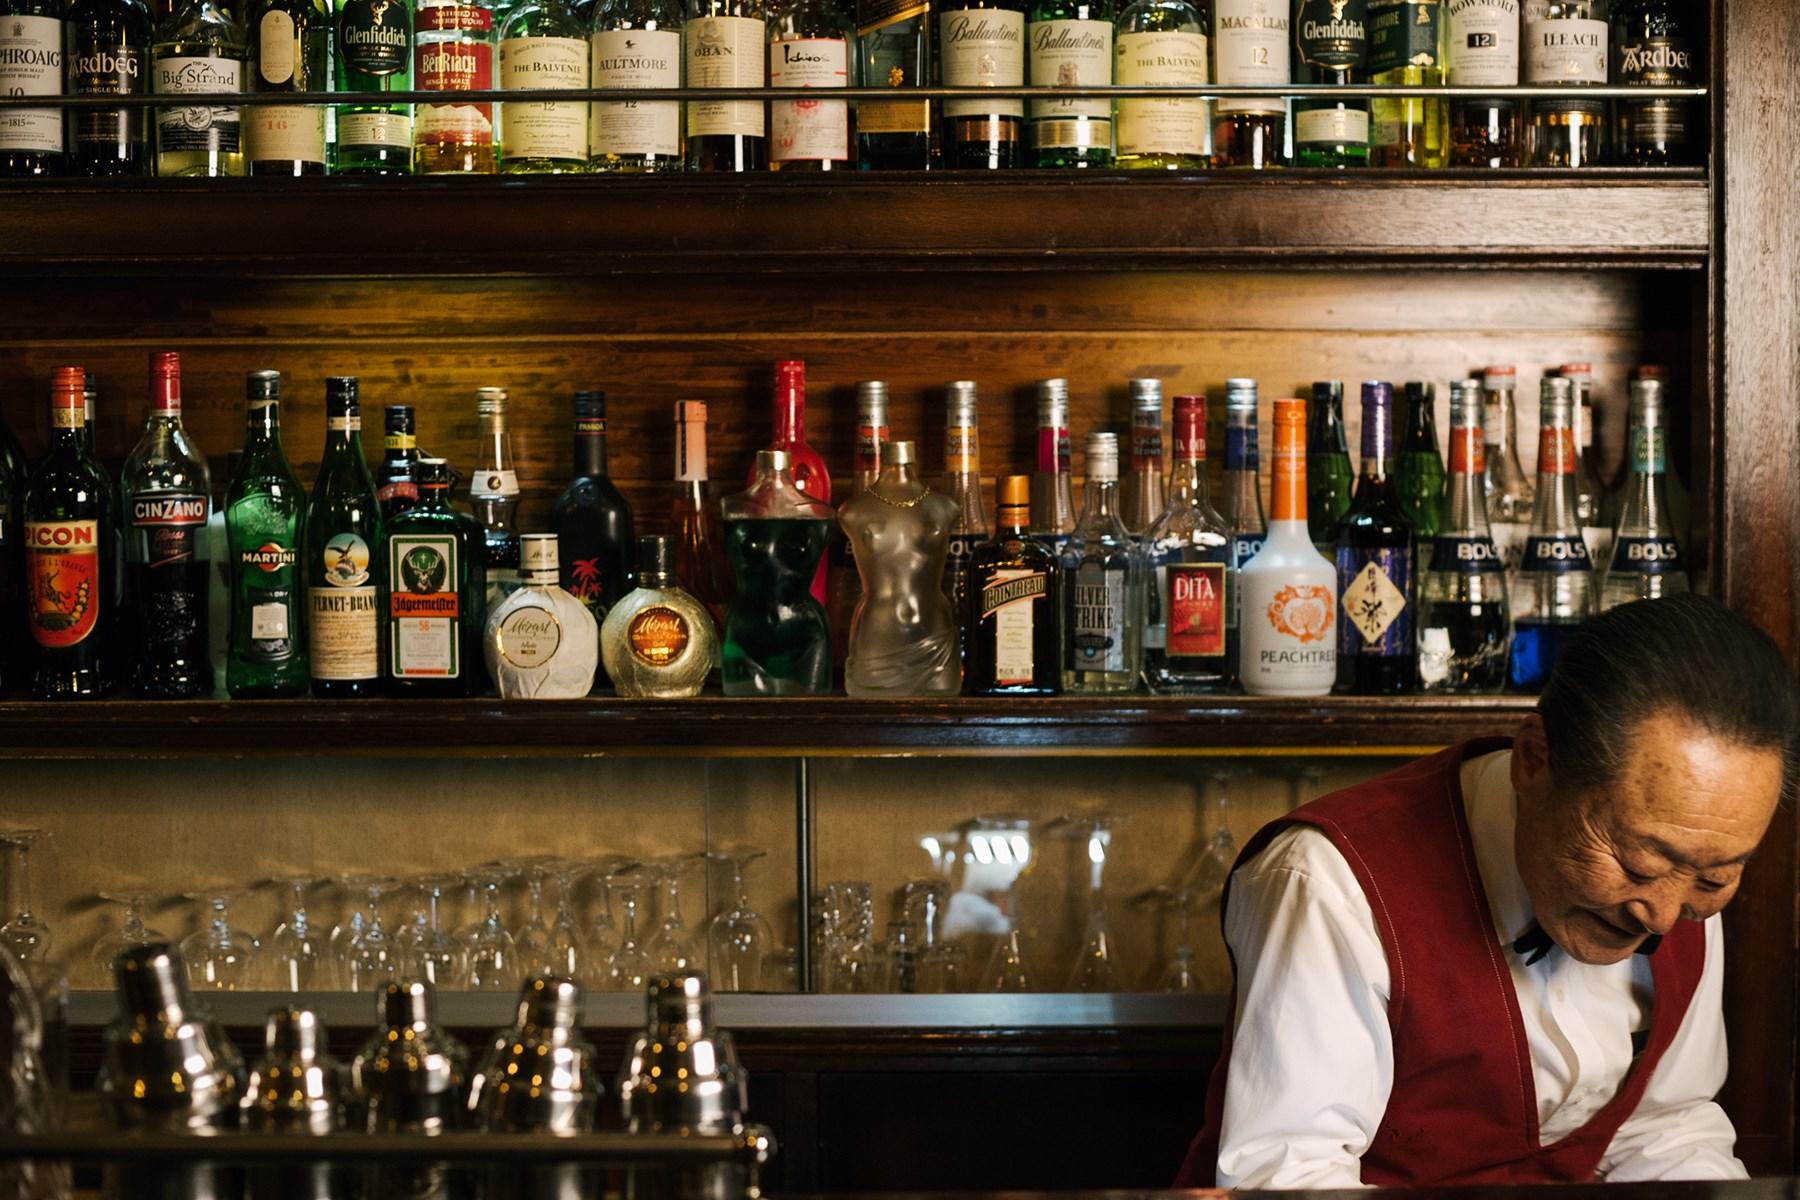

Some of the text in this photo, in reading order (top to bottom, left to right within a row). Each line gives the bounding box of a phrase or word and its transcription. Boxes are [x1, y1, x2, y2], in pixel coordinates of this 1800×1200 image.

[346, 25, 406, 47] Glenfiddich
[1304, 19, 1365, 40] Glenfiddich
[1475, 34, 1490, 46] 12
[1544, 33, 1598, 46] ILEACH
[69, 51, 138, 78] Ardbeg
[599, 58, 668, 71] AULTMORE
[1253, 47, 1269, 65] 12
[513, 62, 583, 74] THE BALVENIE
[163, 69, 234, 88] Big Strand
[9, 118, 26, 127] 1815
[135, 500, 204, 519] CINZANO
[242, 552, 295, 563] MARTINI
[1537, 541, 1586, 560] BOLS
[1628, 542, 1678, 561] BOLS
[985, 577, 1045, 611] COINTREAU
[1176, 577, 1214, 601] DITA
[506, 616, 552, 638] Mozart
[635, 615, 680, 634] Mozart
